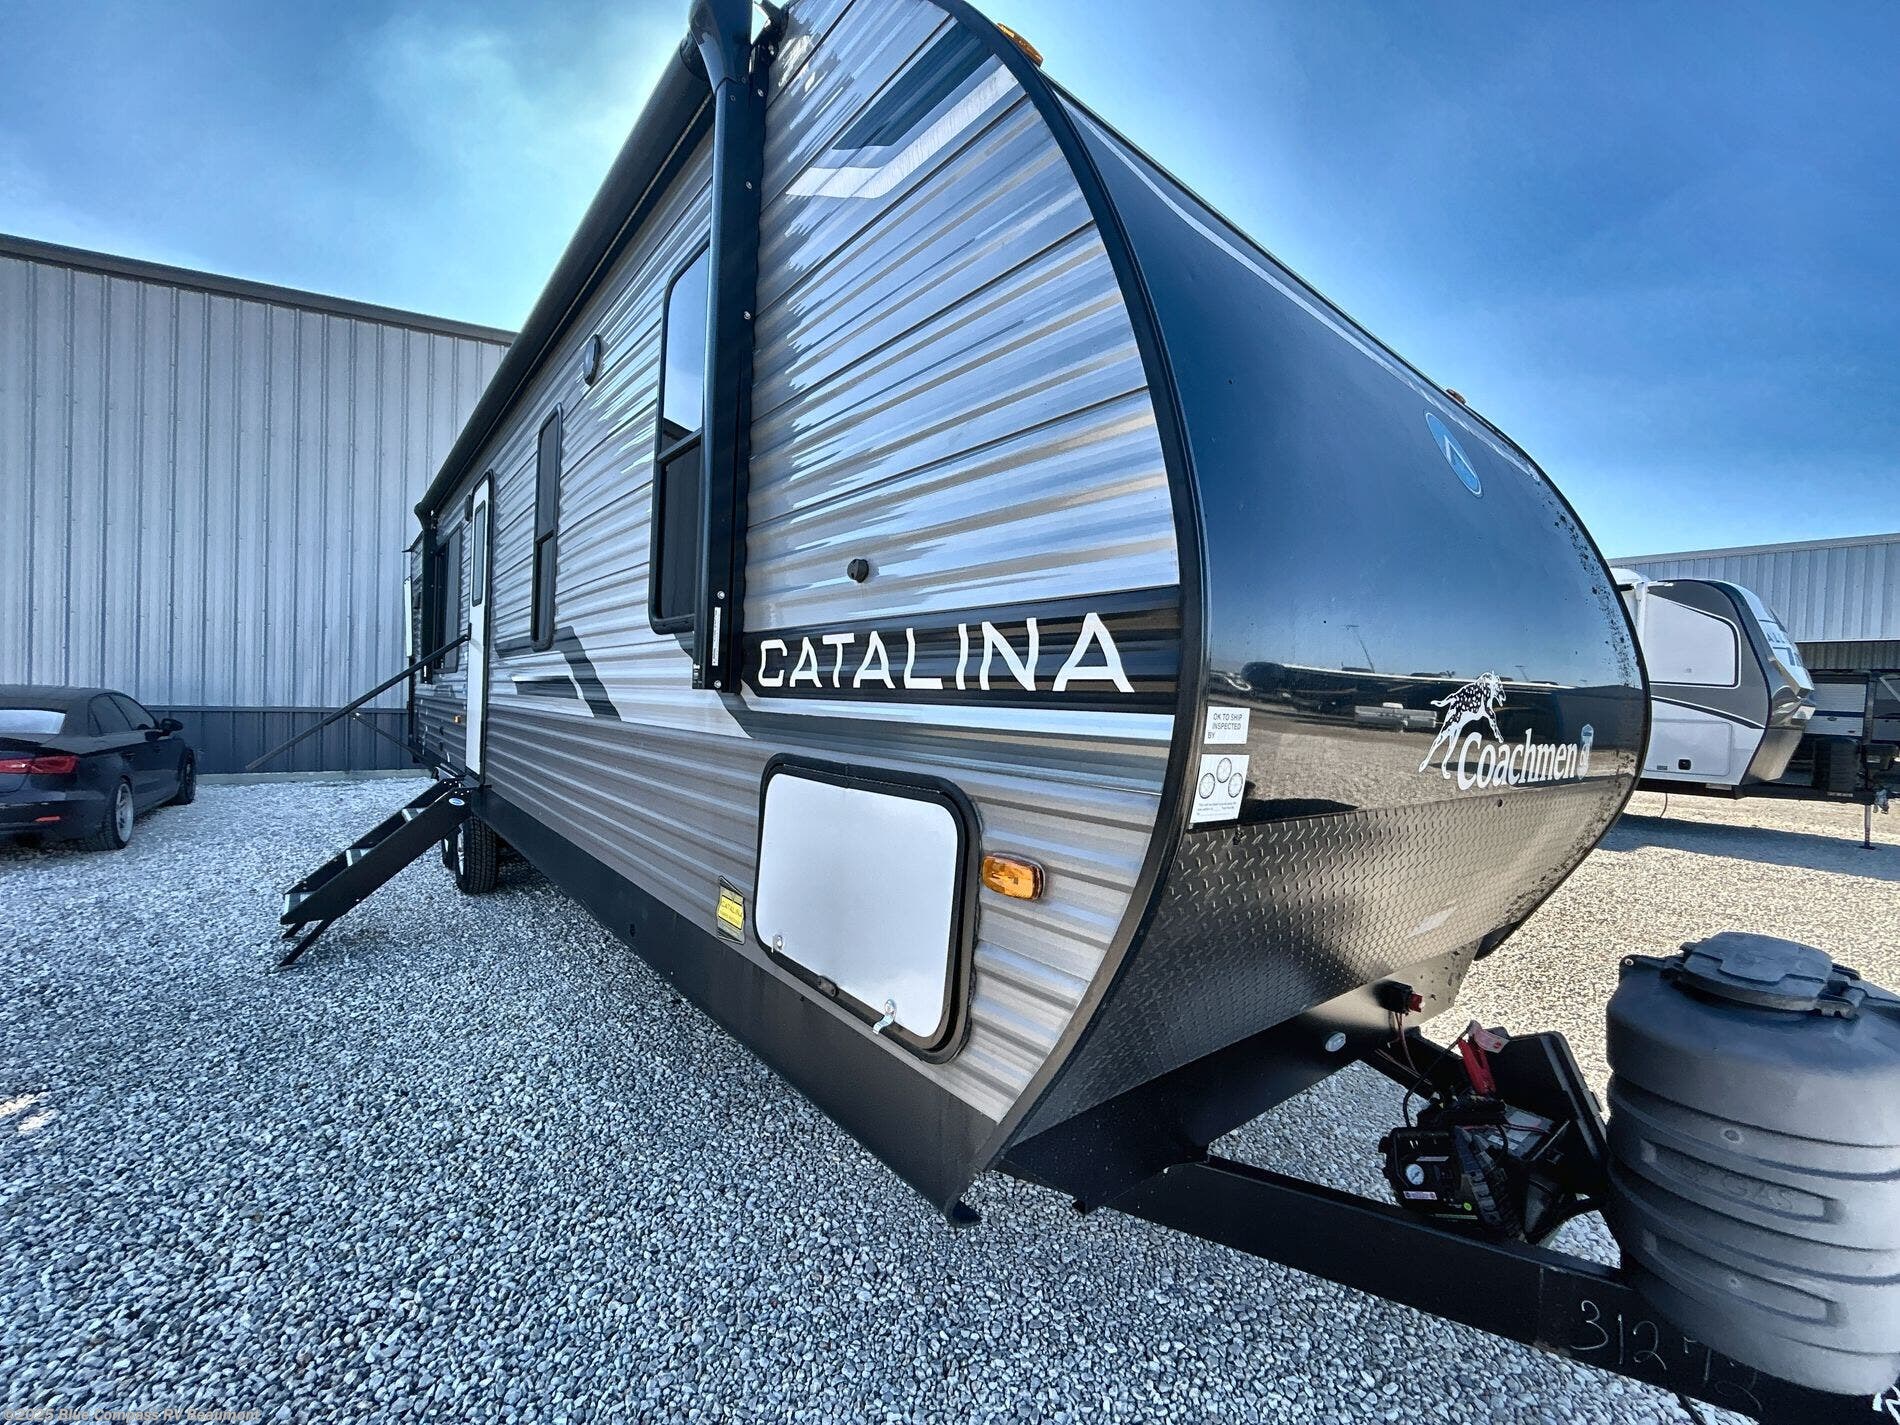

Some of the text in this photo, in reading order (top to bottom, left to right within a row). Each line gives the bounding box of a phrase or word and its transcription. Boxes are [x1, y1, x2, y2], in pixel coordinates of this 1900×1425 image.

[758, 612, 1136, 693] CATALINA
[1213, 713, 1243, 721] OK TO SHIP
[1212, 722, 1242, 730] INSPECTED
[1207, 731, 1216, 739] BY
[1457, 728, 1578, 791] Coachmen
